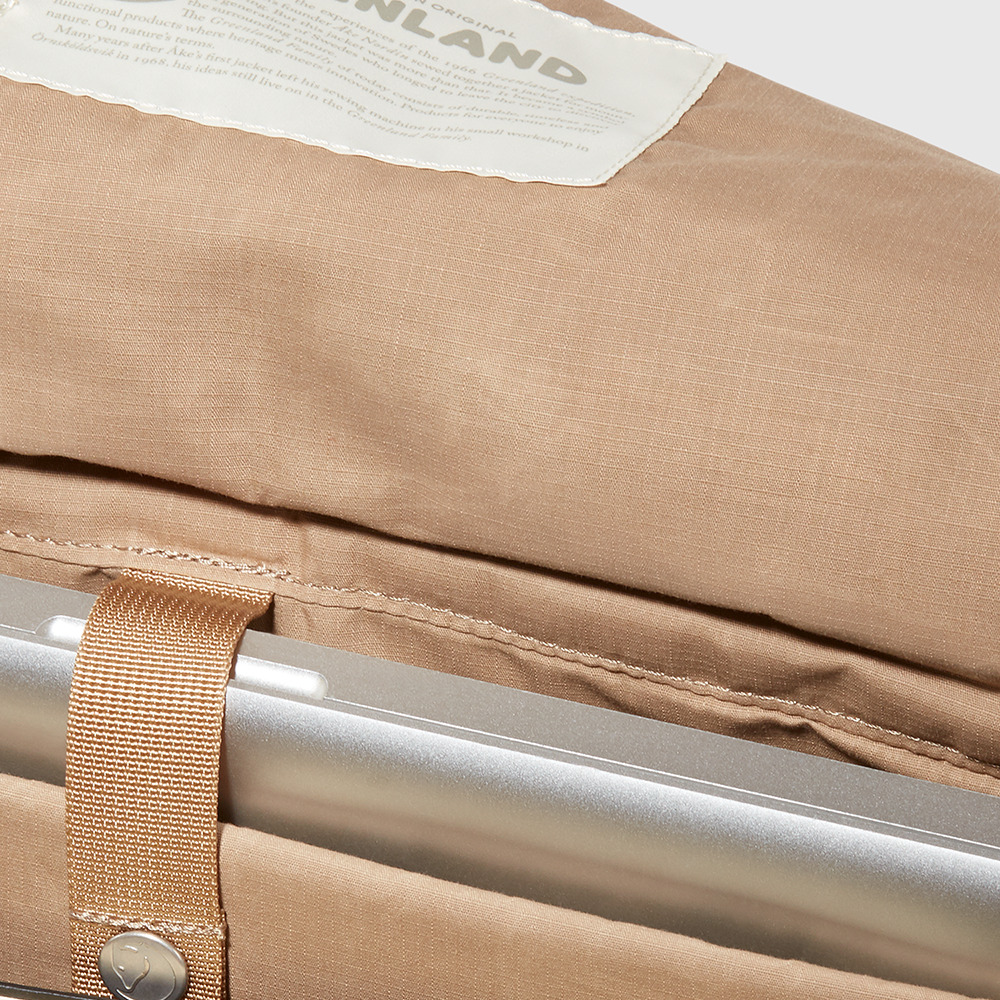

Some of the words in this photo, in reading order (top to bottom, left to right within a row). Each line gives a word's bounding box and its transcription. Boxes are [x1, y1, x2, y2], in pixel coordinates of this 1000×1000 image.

[46, 10, 91, 26] nature.
[95, 18, 117, 32] On
[175, 35, 215, 49] terms.
[211, 6, 291, 38] surrounding
[272, 9, 297, 22] But
[300, 21, 323, 33] this
[326, 31, 364, 50] jacket
[367, 50, 391, 62] was
[394, 61, 427, 77] more
[429, 76, 460, 90] than
[320, 9, 395, 43] experiences
[399, 42, 417, 50] of
[418, 49, 439, 61] the
[335, 0, 587, 85] NLAND
[431, 3, 516, 39] ORIGINAL
[54, 24, 97, 44] Many
[95, 35, 130, 49] years
[131, 41, 162, 54] after
[203, 52, 233, 65] first
[230, 57, 275, 75] jacket
[275, 69, 300, 82] left
[300, 77, 321, 90] his
[322, 87, 367, 113] sewing
[369, 110, 425, 130] machine
[507, 131, 574, 149] workshop
[576, 143, 590, 152] in
[122, 12, 182, 31] products
[185, 25, 225, 39] where
[228, 32, 282, 54] heritage
[285, 52, 323, 70] meets
[326, 67, 397, 106] innovation.
[401, 102, 460, 117] Products
[181, 7, 206, 22] The
[210, 16, 284, 43] Greenland
[286, 42, 334, 64] Family
[355, 72, 391, 92] today
[392, 91, 444, 108] consists
[311, 32, 358, 57] Swedes
[362, 56, 389, 72] who
[392, 69, 437, 91] longed
[410, 59, 452, 77] sewed
[453, 73, 509, 90] together
[116, 51, 130, 61] in
[172, 59, 191, 72] his
[194, 65, 229, 76] ideas
[231, 71, 258, 82] still
[258, 77, 283, 90] live
[284, 86, 302, 96] on
[304, 91, 320, 101] in
[322, 98, 343, 111] the
[347, 109, 420, 138] Greenland
